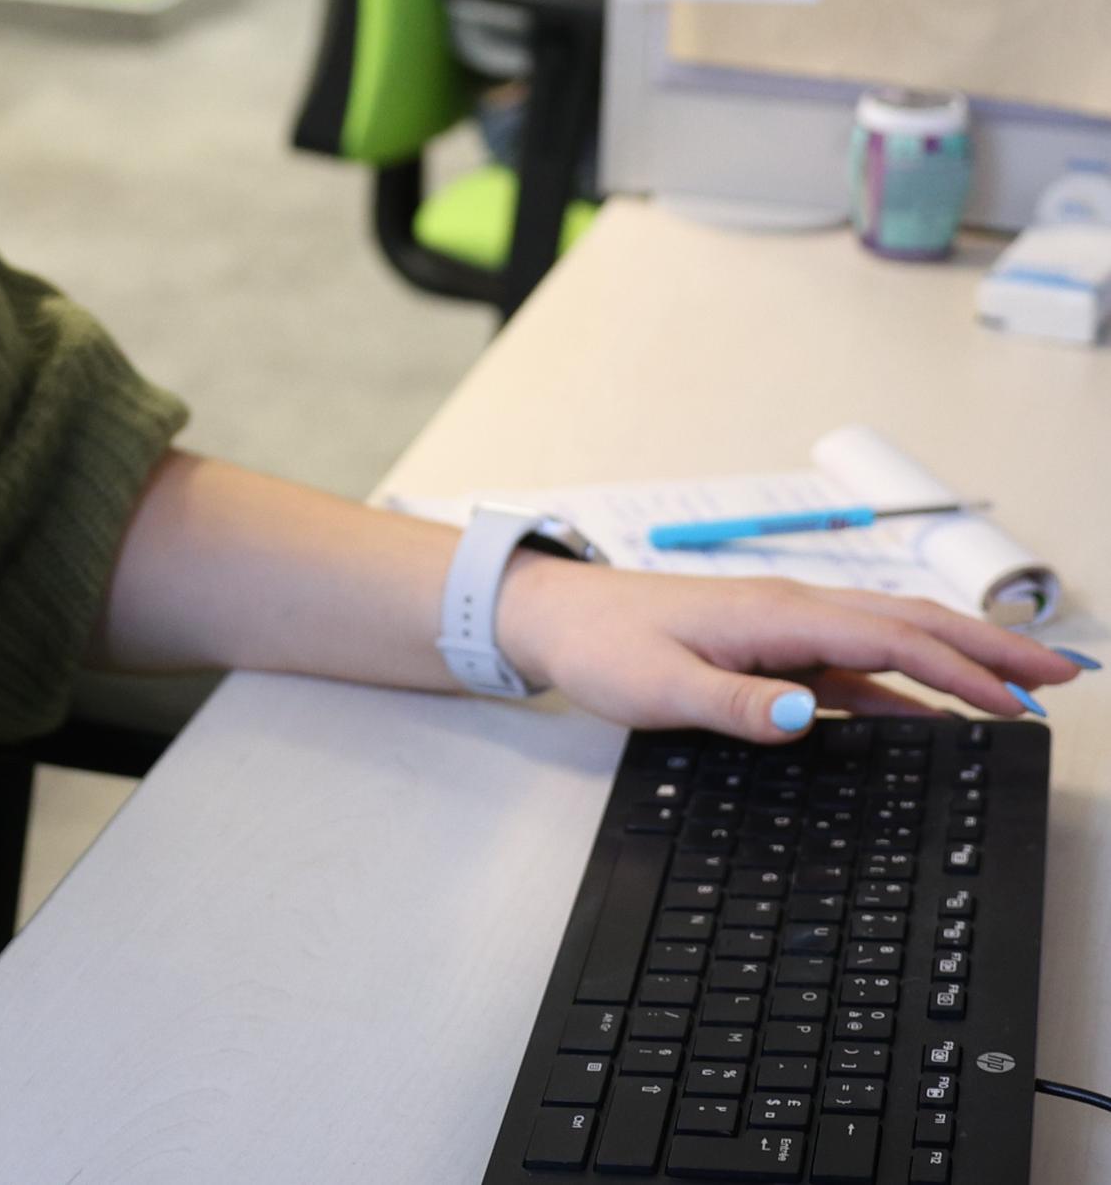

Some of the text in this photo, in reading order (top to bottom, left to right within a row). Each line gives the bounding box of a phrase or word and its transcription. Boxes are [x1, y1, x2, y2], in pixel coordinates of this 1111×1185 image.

[976, 1052, 1016, 1074] hp
[777, 1138, 792, 1162] Entrée
[930, 1151, 943, 1165] F12
